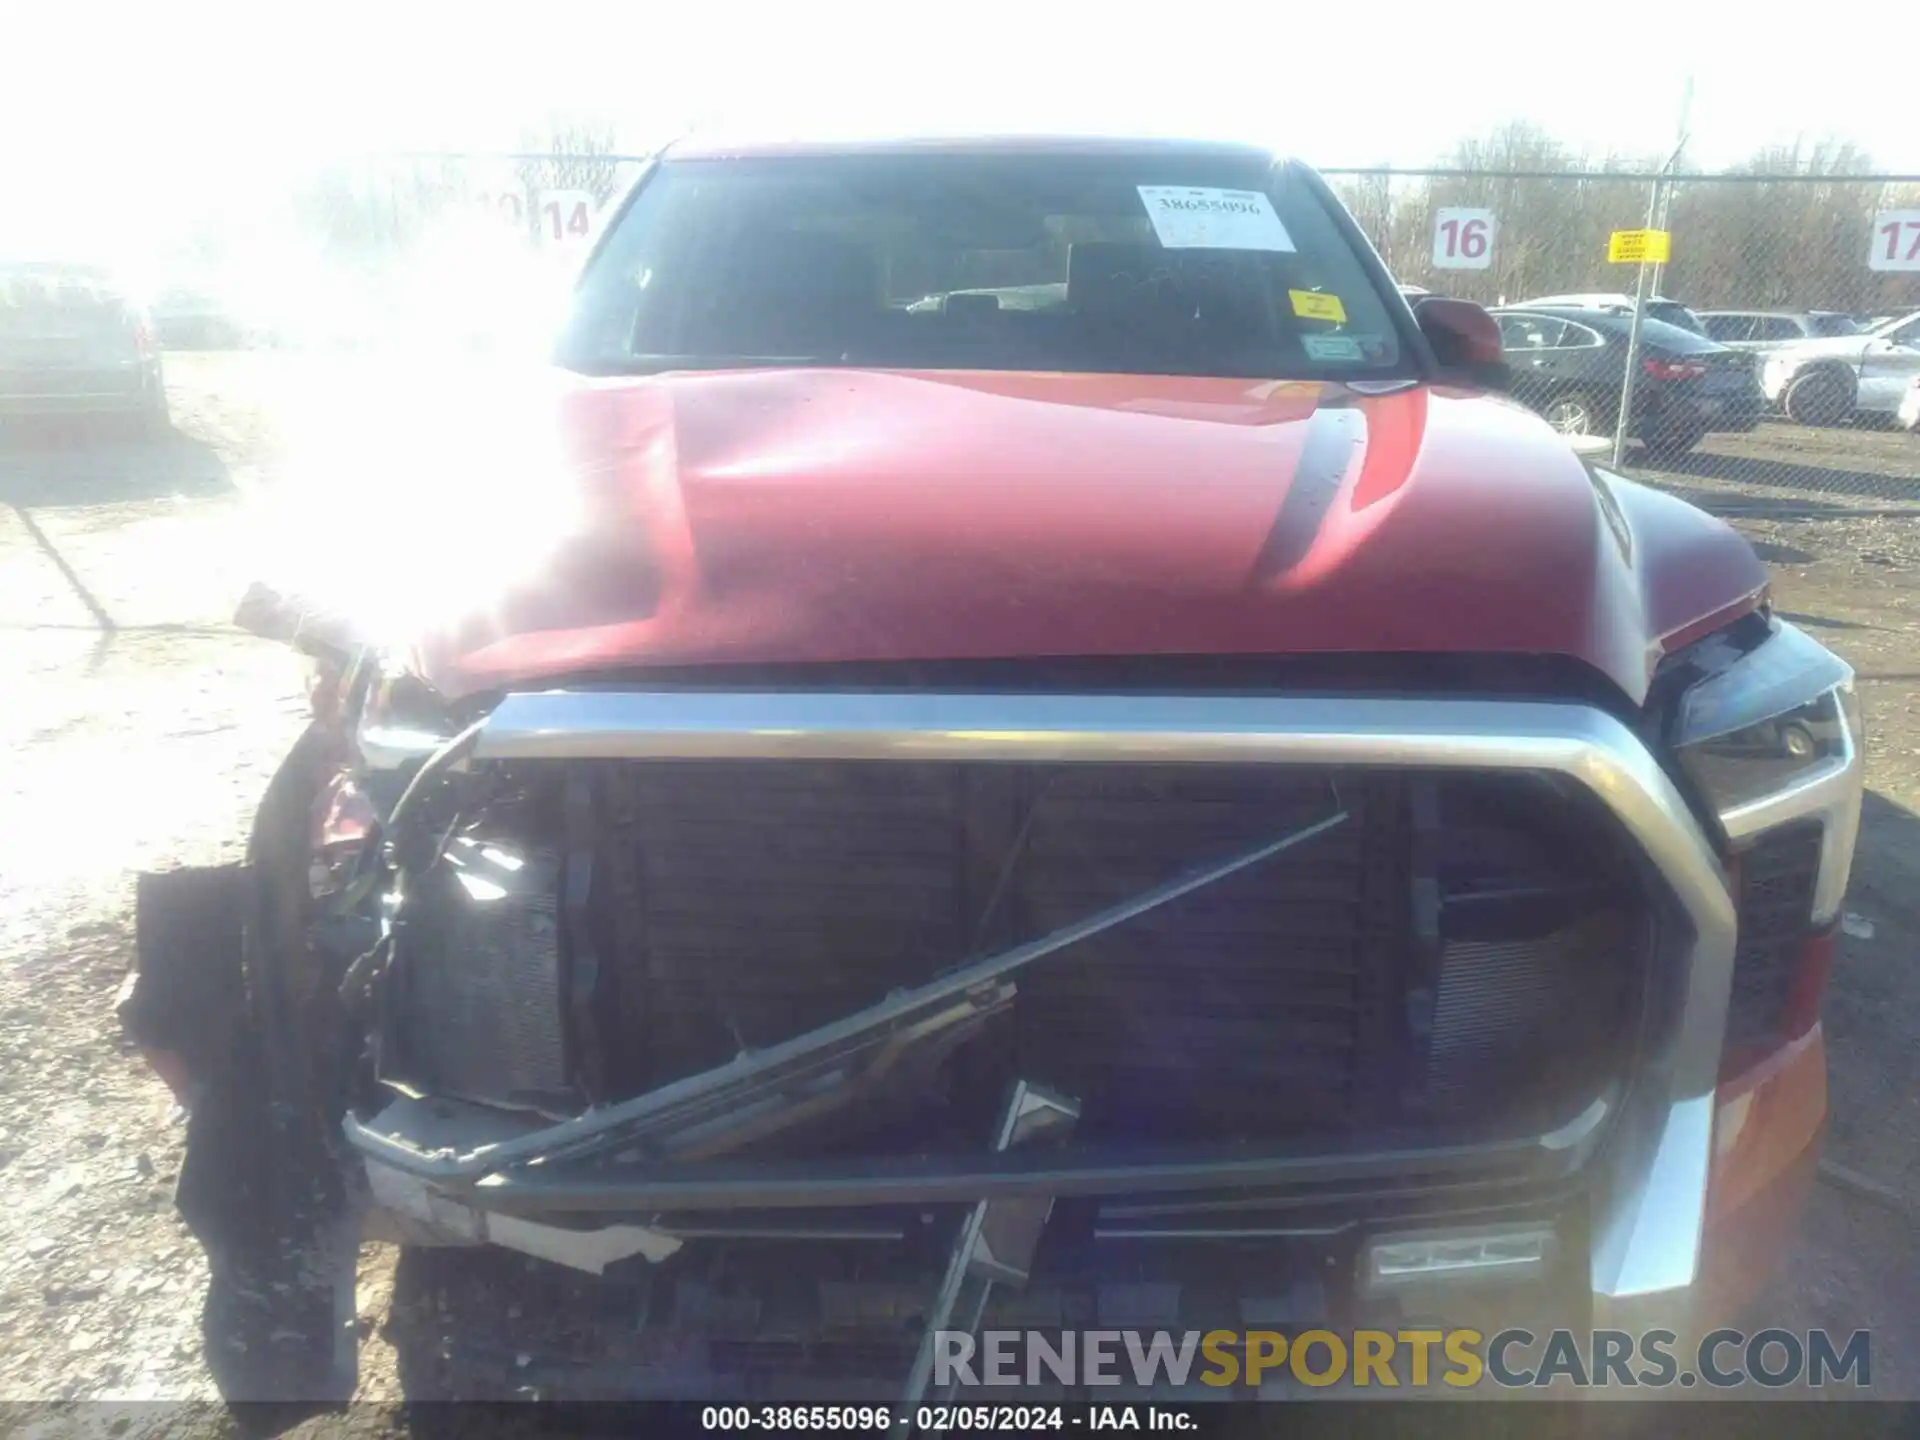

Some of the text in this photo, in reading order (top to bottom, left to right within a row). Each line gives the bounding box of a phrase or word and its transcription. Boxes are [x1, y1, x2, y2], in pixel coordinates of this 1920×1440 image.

[544, 200, 589, 240] 14
[1440, 218, 1488, 258] 16
[1880, 221, 1920, 261] 17
